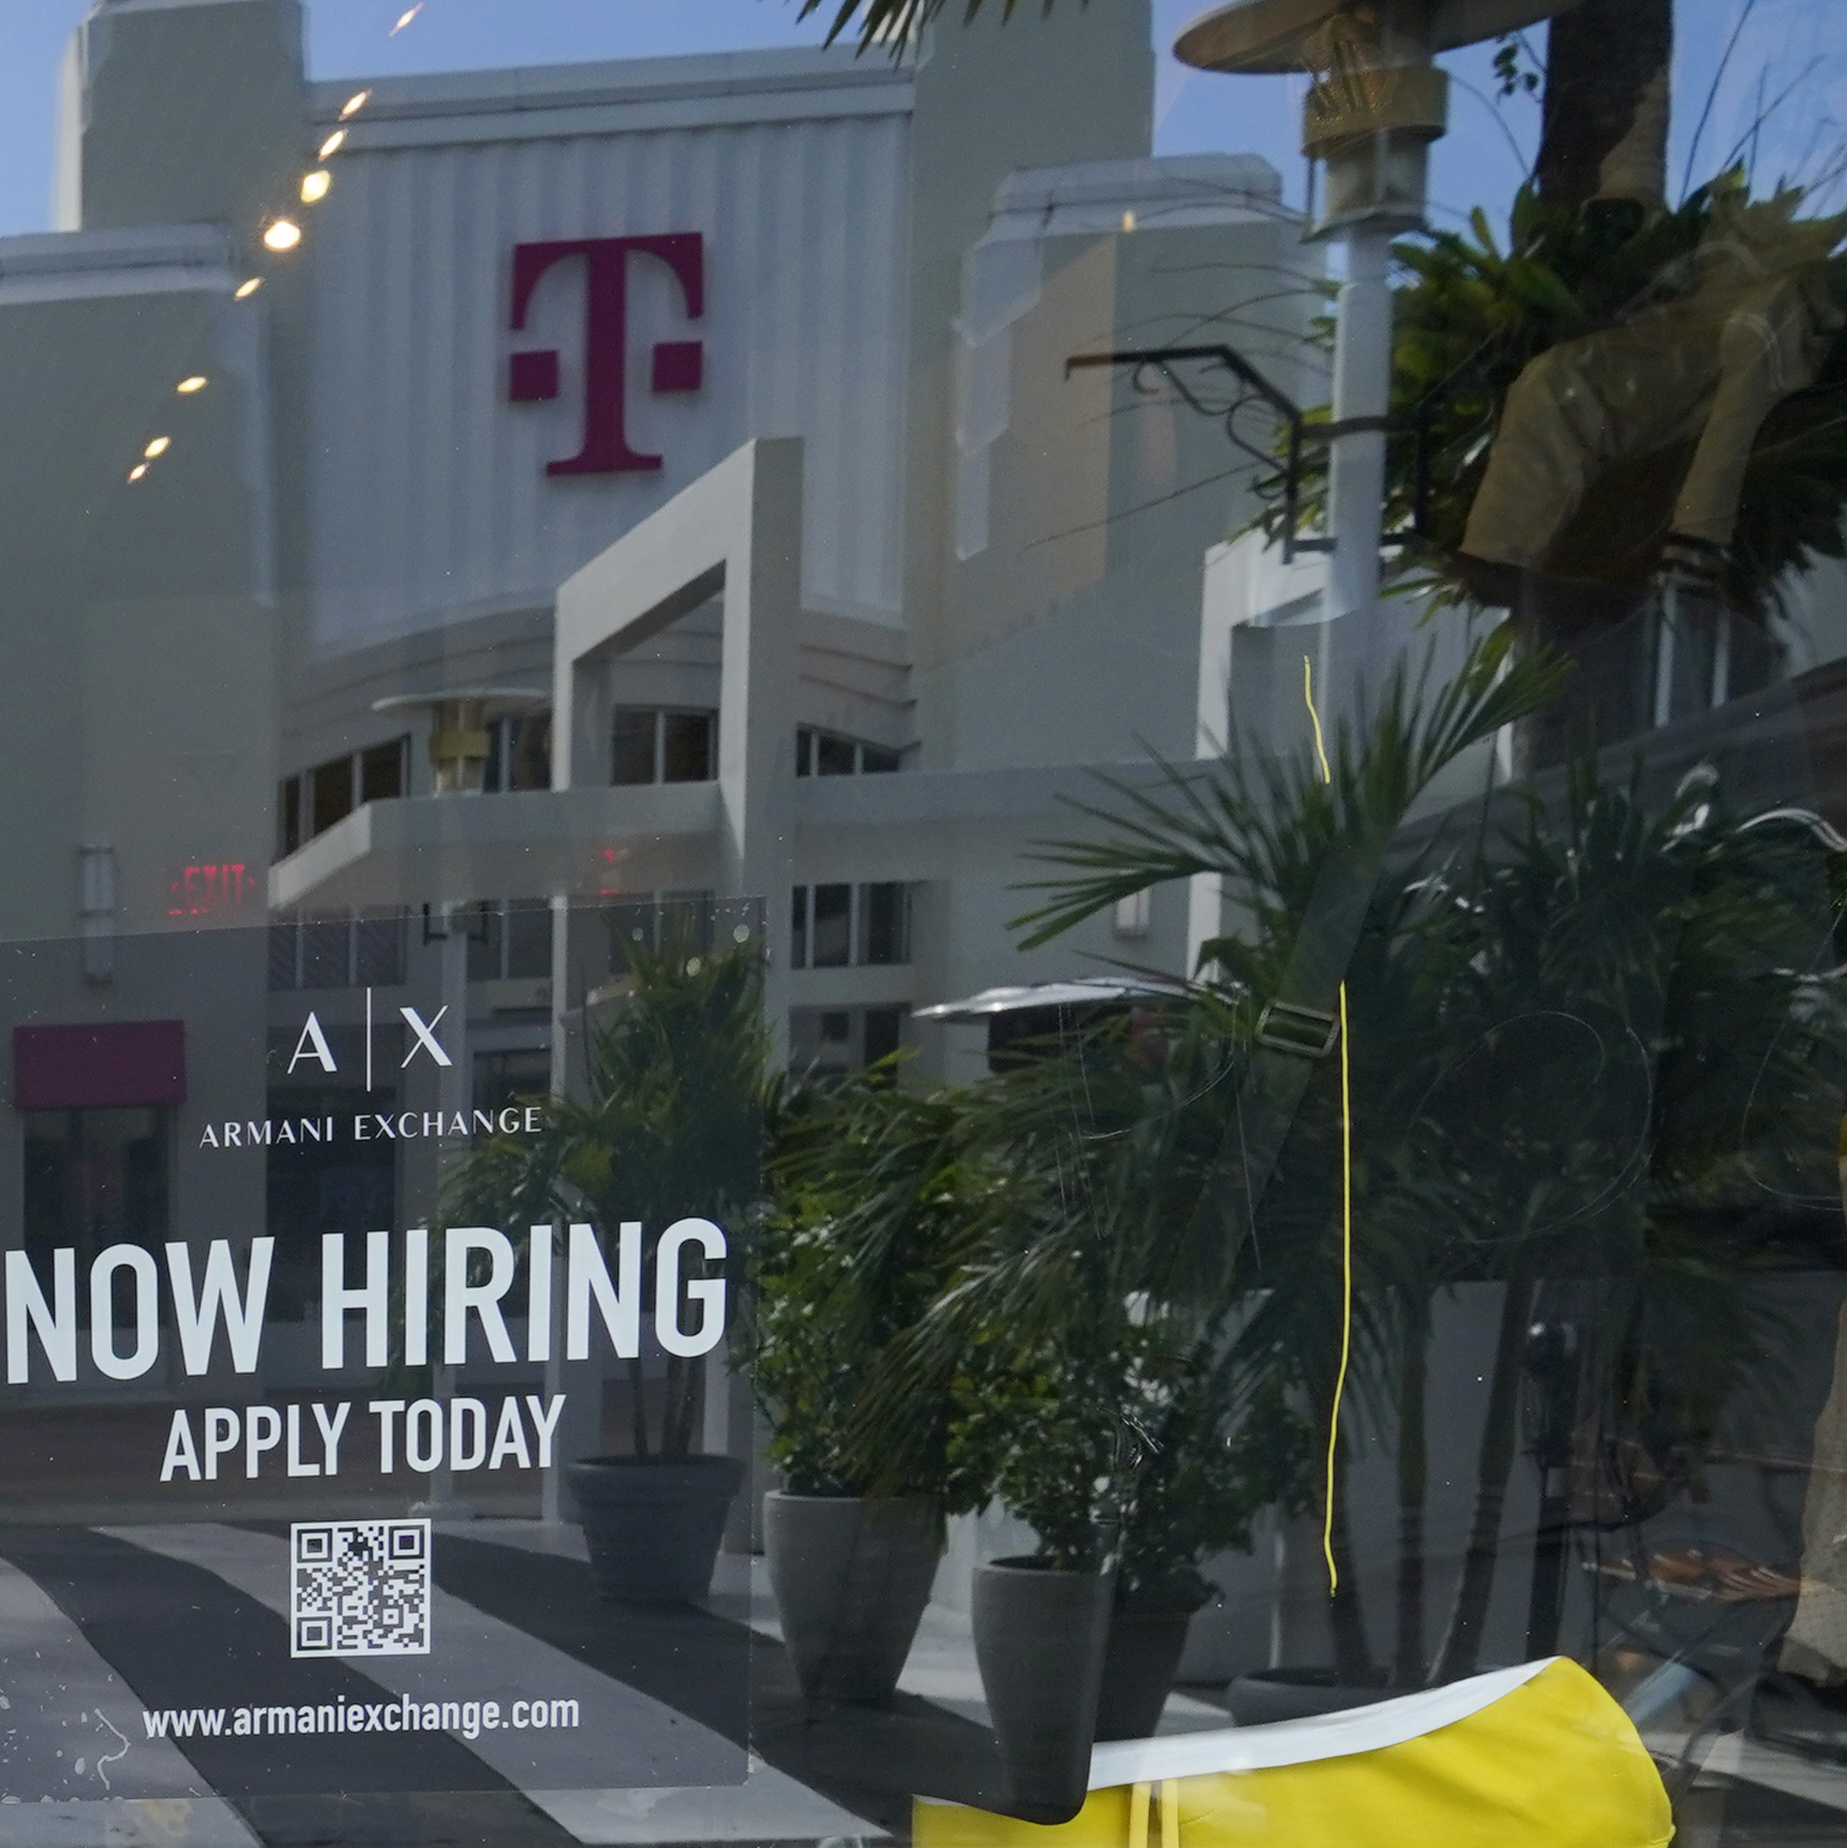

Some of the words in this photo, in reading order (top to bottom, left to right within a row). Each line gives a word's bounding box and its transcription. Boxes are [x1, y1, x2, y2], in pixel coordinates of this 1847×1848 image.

[198, 1116, 337, 1150] ARMANI
[353, 1106, 544, 1143] EXCHANGE
[4, 1236, 275, 1386] NOW
[320, 1218, 728, 1371] HIRING
[159, 1401, 352, 1483] APPLY
[369, 1395, 567, 1475] TODAY
[142, 1692, 580, 1742] www.armaniexchange.com
